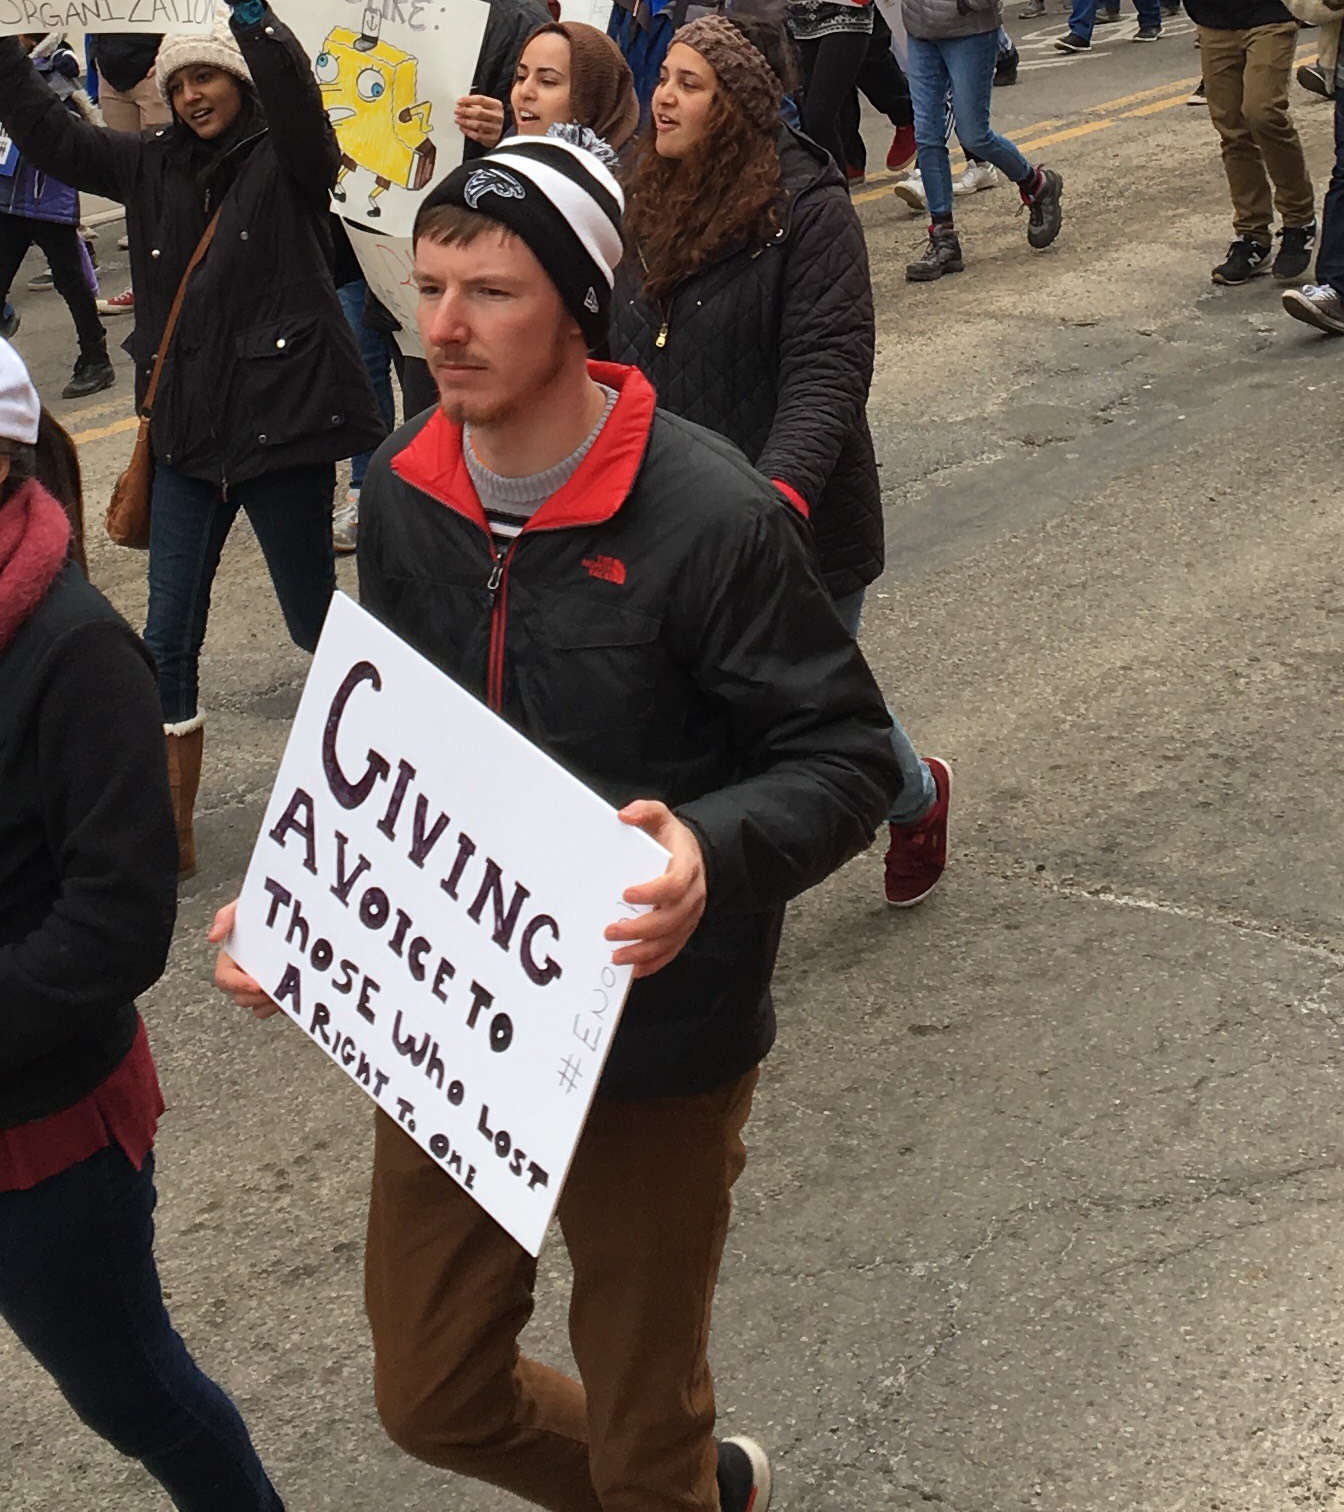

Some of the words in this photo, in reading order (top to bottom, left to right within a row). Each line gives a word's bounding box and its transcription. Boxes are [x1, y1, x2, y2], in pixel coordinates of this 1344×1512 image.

[321, 660, 564, 987] GIVING
[269, 787, 319, 876] A
[330, 829, 455, 1004] VOICE
[466, 977, 514, 1054] TO
[275, 962, 303, 1016] A
[476, 1102, 550, 1193] LOST
